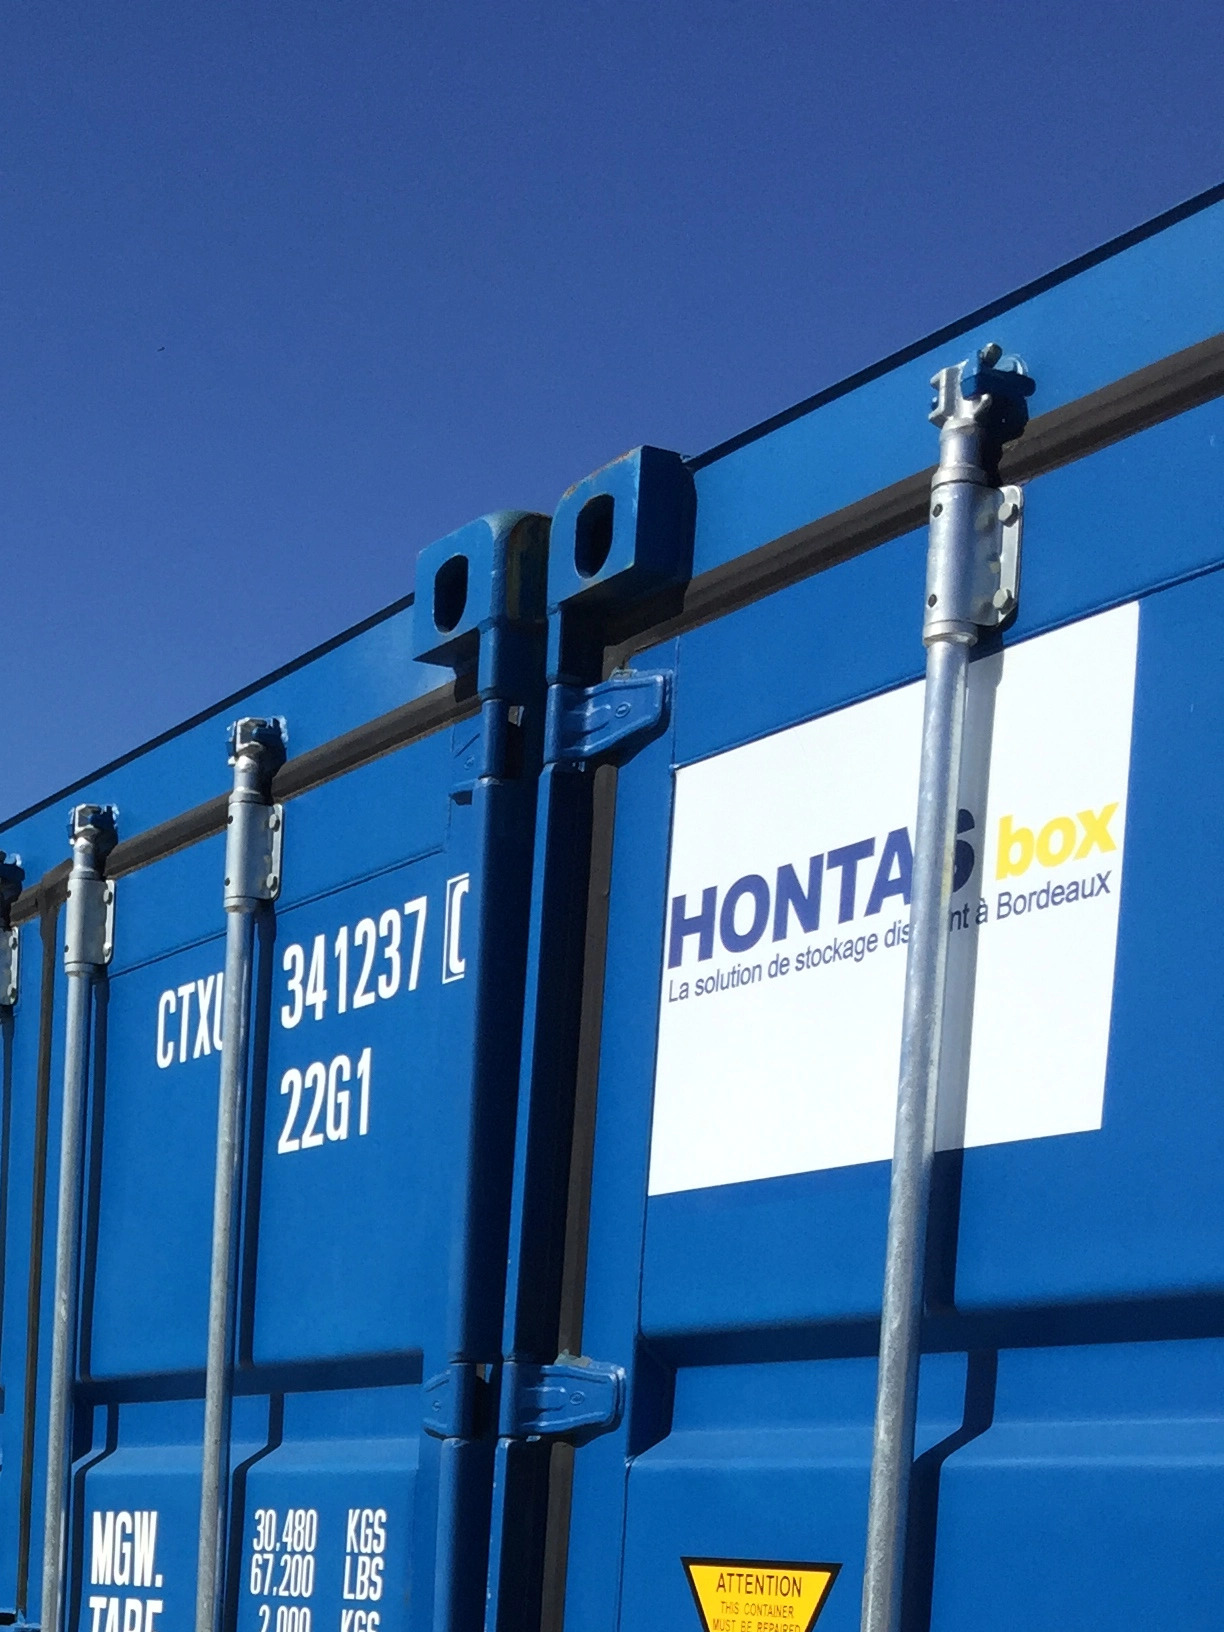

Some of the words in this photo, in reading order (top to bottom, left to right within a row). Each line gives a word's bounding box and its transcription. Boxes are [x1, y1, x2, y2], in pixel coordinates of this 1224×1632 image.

[995, 802, 1119, 880] box
[281, 895, 428, 1029] 341237
[668, 979, 689, 1003] La
[694, 957, 763, 998] solution
[768, 952, 791, 979] de
[794, 932, 879, 973] stockage
[884, 902, 970, 949] disnt
[975, 897, 989, 926] à
[996, 870, 1112, 920] Bordeaux
[277, 1047, 372, 1156] 22G1
[91, 1511, 163, 1588] MGW.
[346, 1509, 386, 1553] KGS
[343, 1556, 383, 1601] LBS
[716, 1572, 802, 1598] ATTENTION
[713, 1618, 736, 1632] MUST
[721, 1601, 739, 1615] THIS
[744, 1602, 794, 1619] CONTAINER
